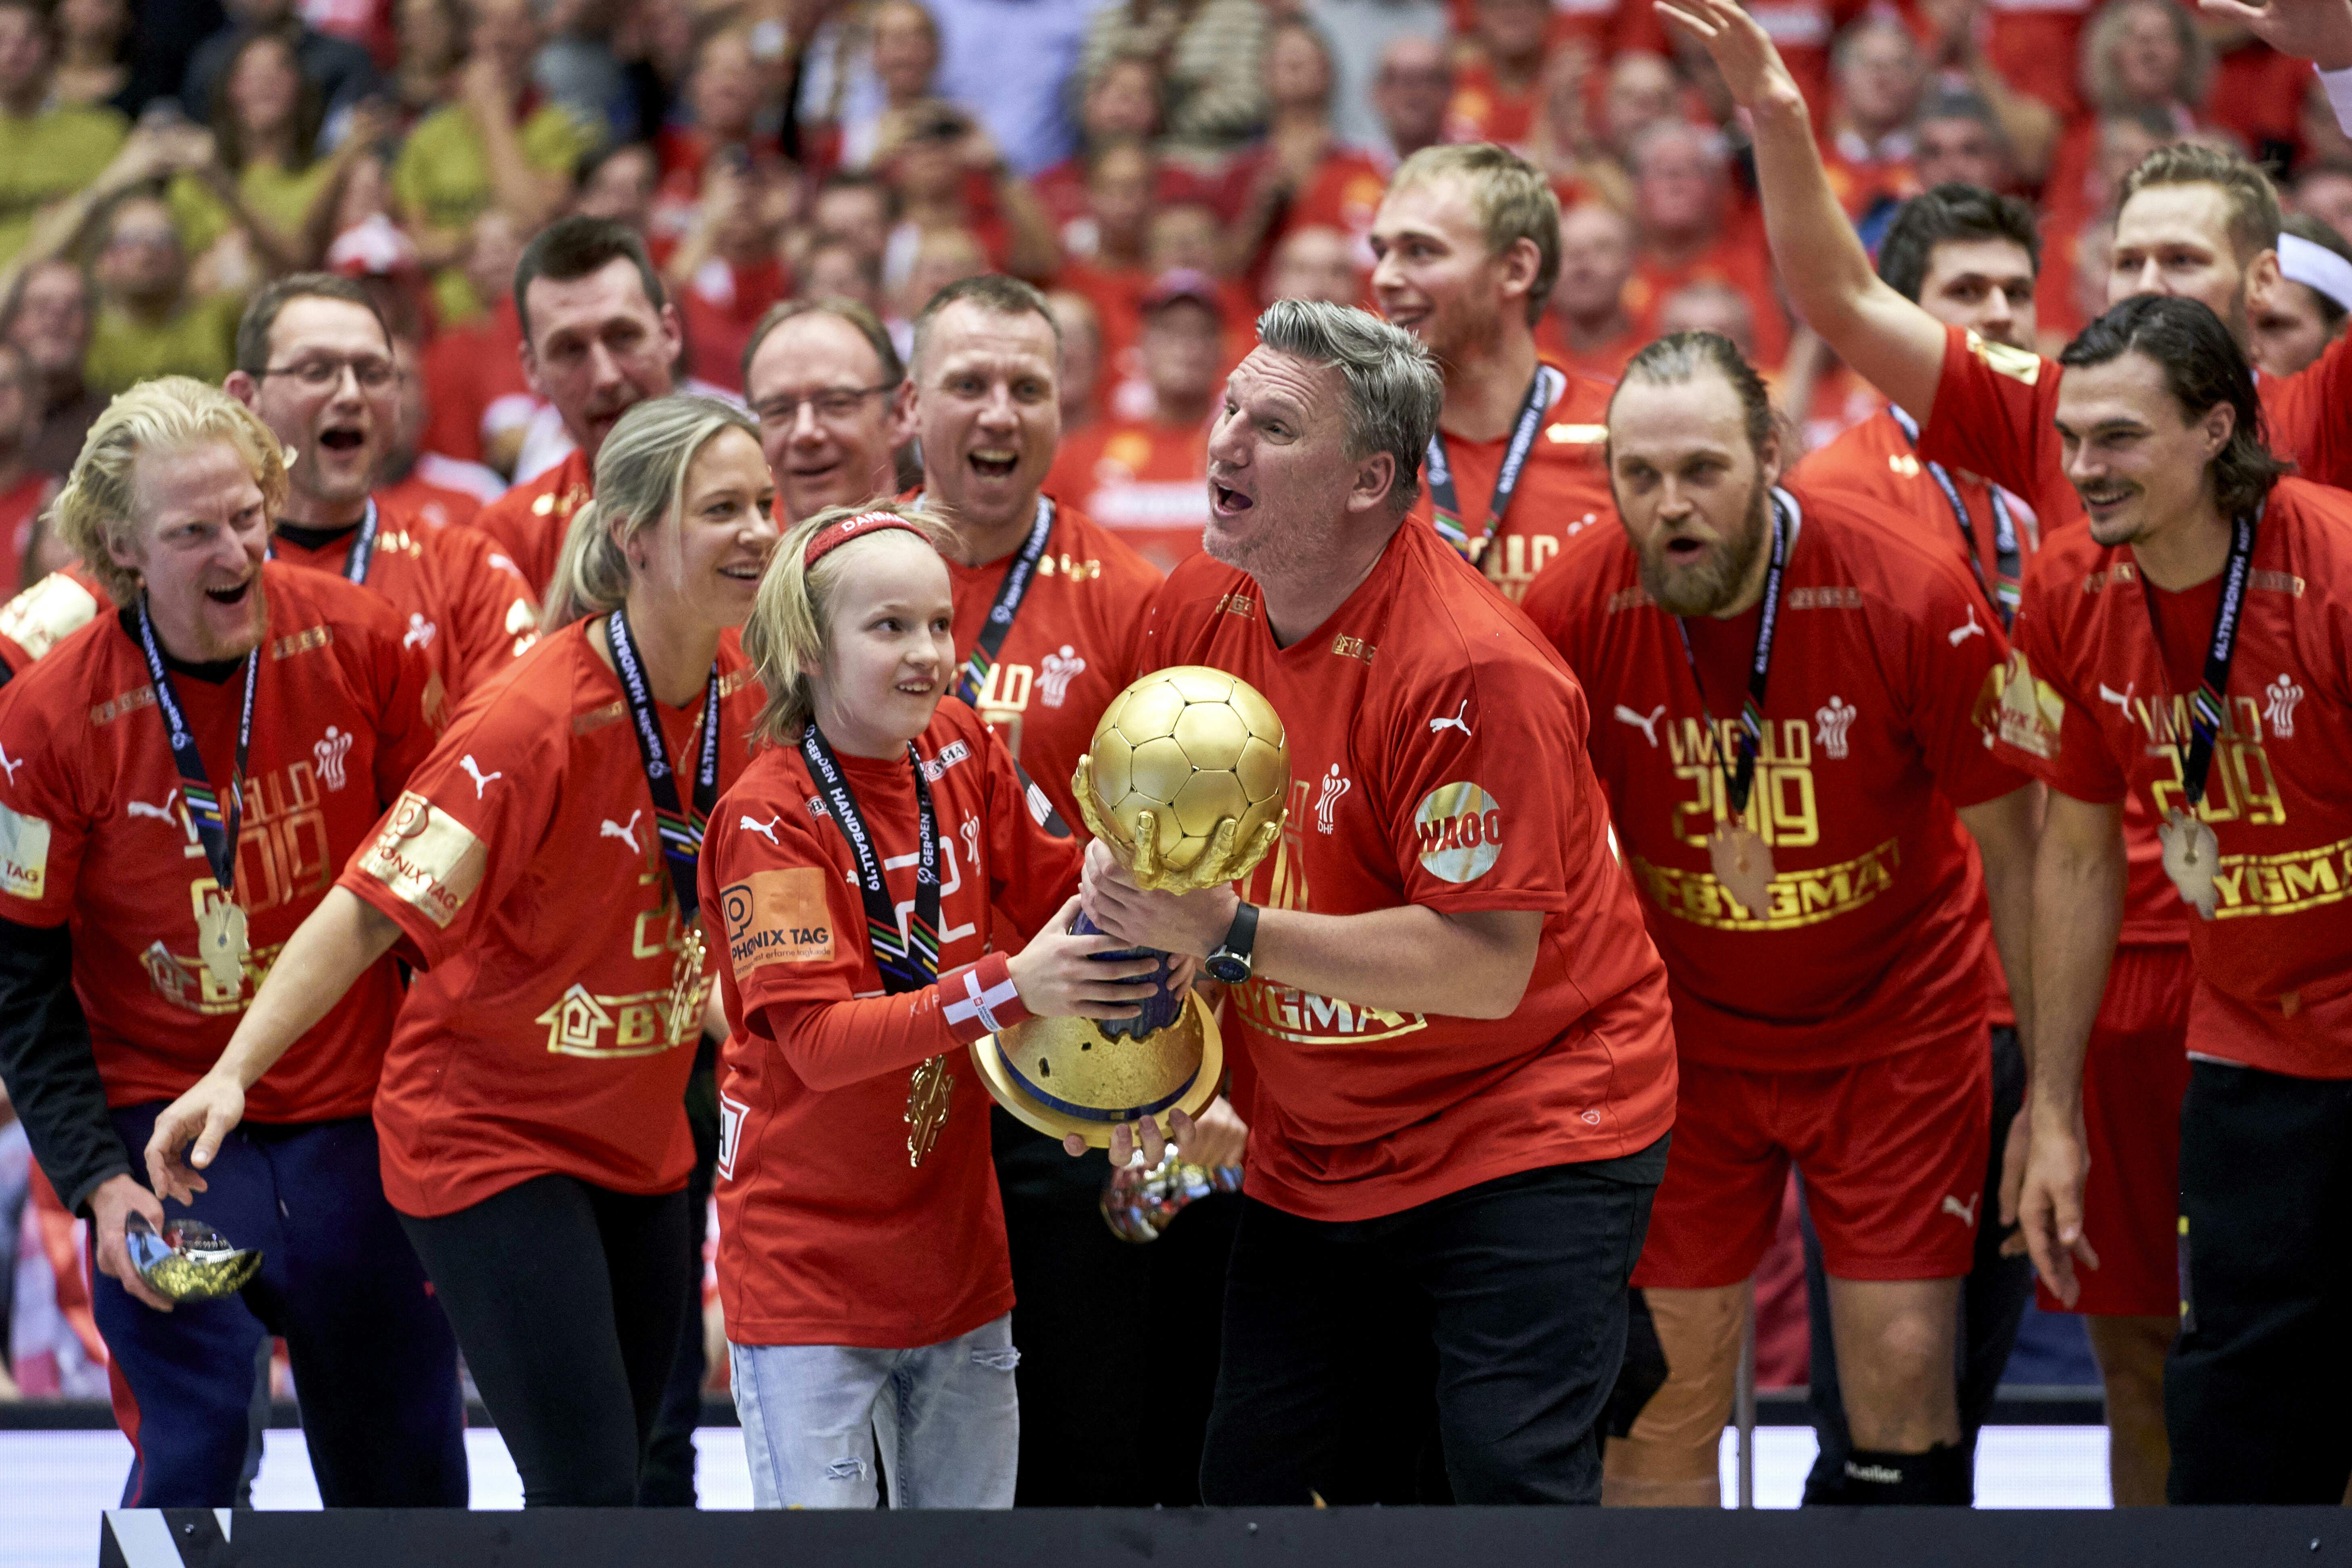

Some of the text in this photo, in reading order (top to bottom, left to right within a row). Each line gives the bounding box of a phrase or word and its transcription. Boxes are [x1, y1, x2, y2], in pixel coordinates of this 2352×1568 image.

[806, 738, 880, 892] GERDEN HANDBALL'19
[1317, 820, 1334, 835] DHF
[920, 812, 934, 867] GERDEN
[6, 859, 39, 883] TAG
[2212, 849, 2352, 907] YGM
[790, 927, 828, 945] TAG
